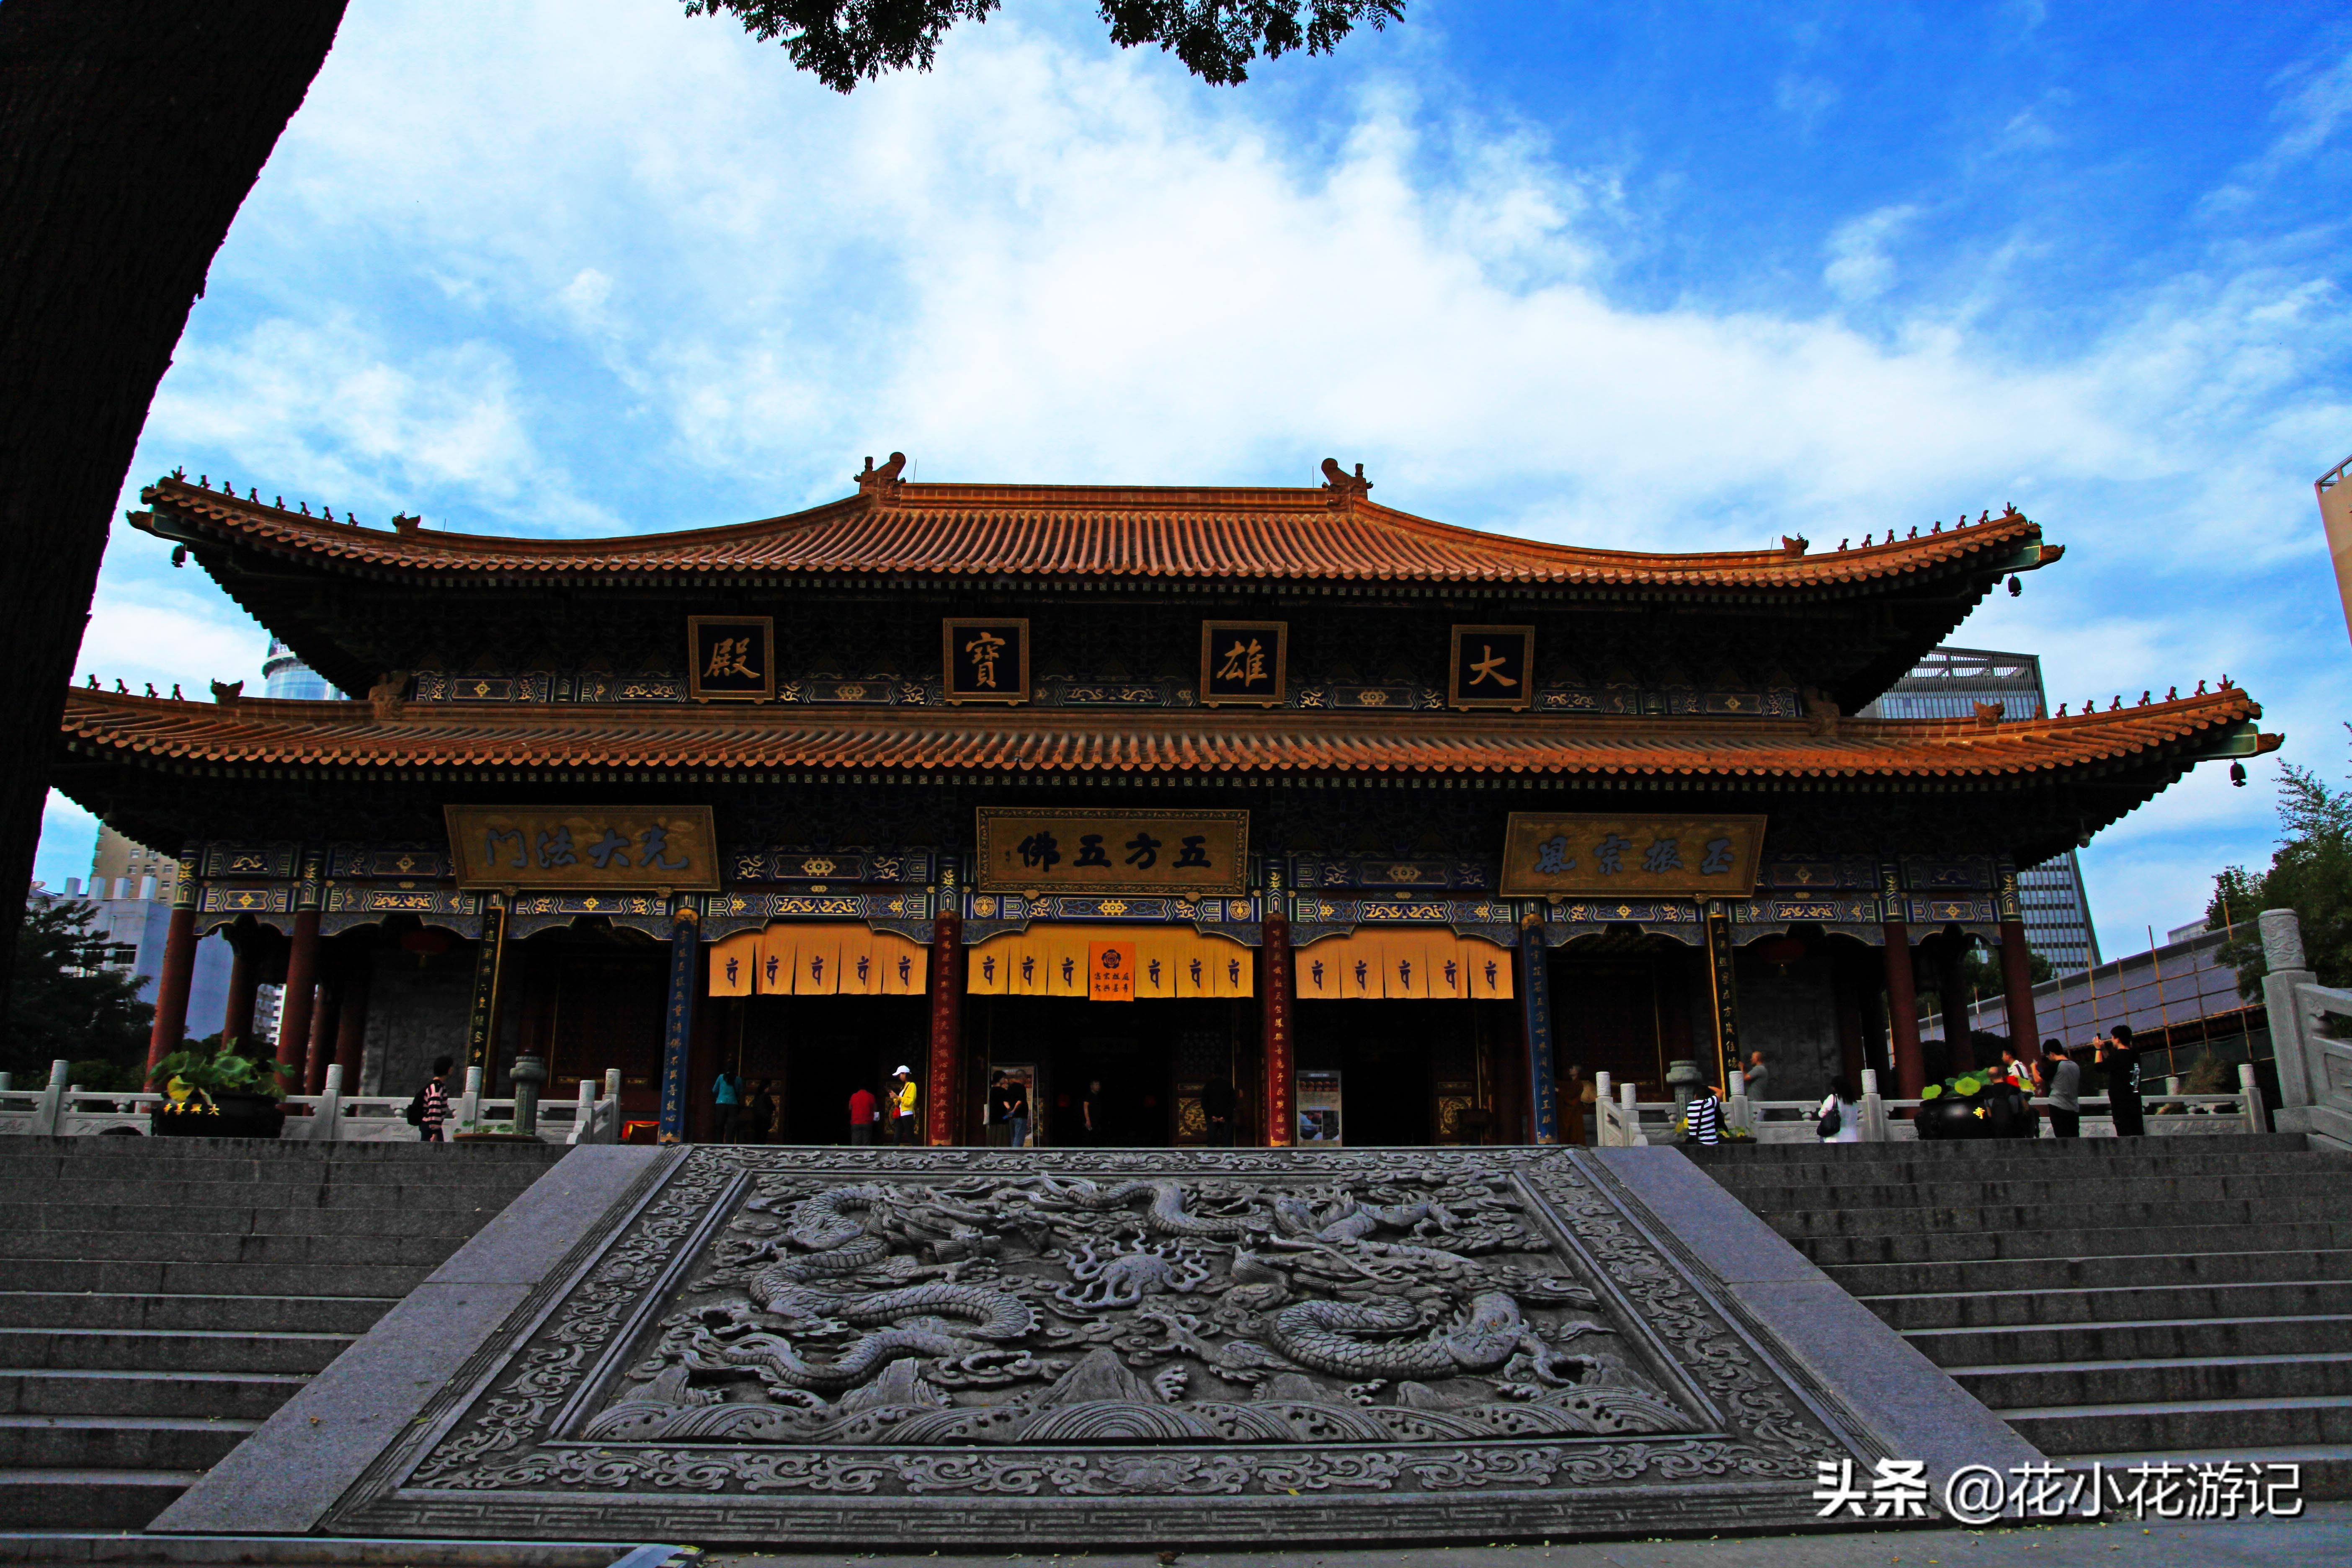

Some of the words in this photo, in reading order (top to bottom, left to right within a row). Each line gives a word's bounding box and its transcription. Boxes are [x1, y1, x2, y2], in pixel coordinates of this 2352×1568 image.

[704, 636, 761, 679] 殿
[965, 631, 1006, 689] 寶
[1216, 637, 1269, 687] 雄
[1468, 644, 1519, 687] 大
